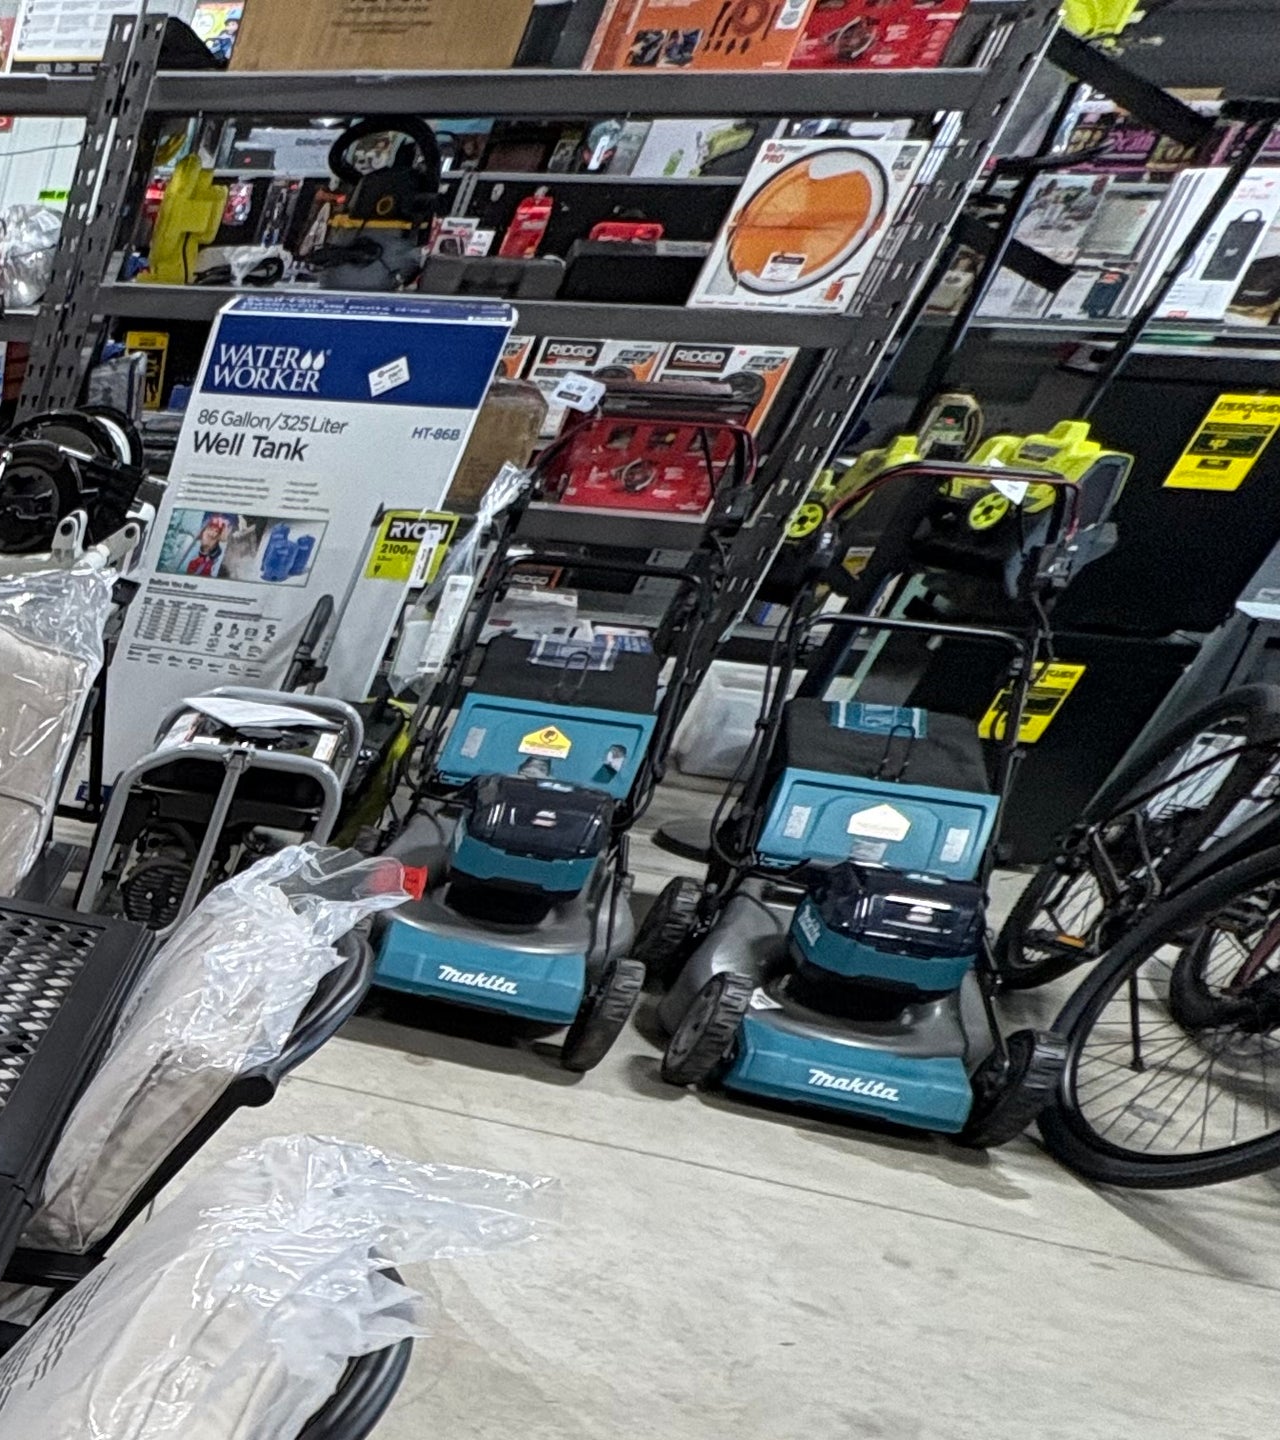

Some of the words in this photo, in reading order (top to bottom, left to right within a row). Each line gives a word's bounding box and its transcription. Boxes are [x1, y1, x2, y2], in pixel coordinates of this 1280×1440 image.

[219, 343, 301, 369] WATER
[547, 344, 596, 359] RIDGID
[675, 349, 725, 364] RIDGID
[214, 364, 321, 393] WORKER
[198, 408, 220, 426] 86
[309, 415, 349, 434] Liter
[411, 427, 461, 441] HT-86B
[193, 430, 246, 457] Well
[251, 434, 310, 462] Tank
[390, 521, 449, 541] RYOI
[380, 543, 408, 556] 2100
